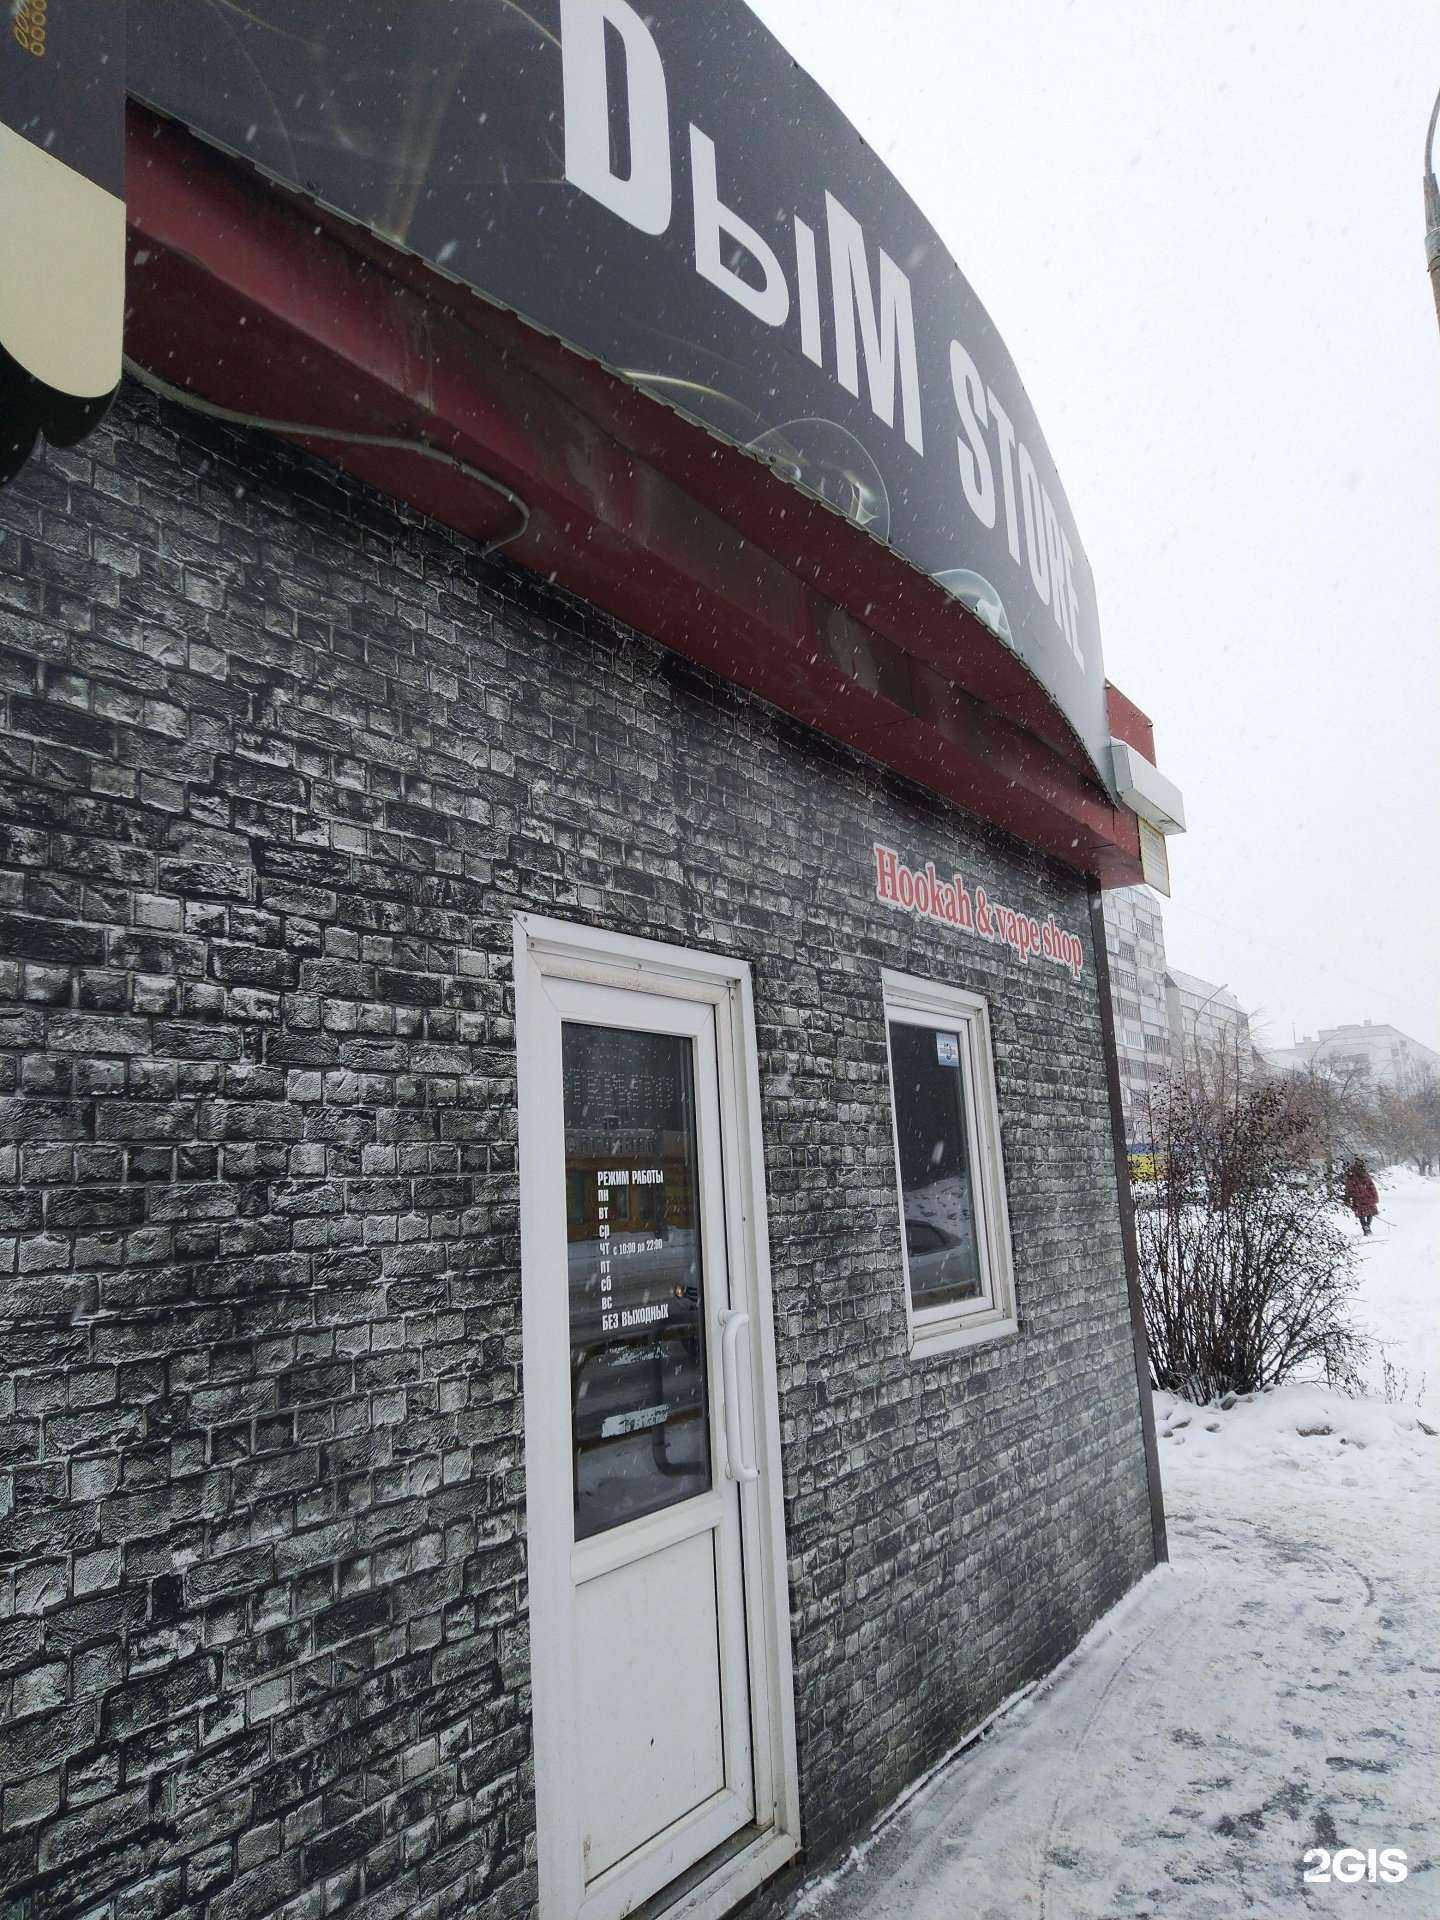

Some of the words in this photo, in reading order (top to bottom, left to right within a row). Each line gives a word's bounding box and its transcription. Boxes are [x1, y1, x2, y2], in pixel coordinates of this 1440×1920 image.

[949, 339, 1086, 675] STORE
[875, 845, 974, 931] Hookah
[975, 887, 995, 940] &
[994, 904, 1041, 961] vape
[1042, 915, 1084, 979] shop
[597, 1170, 629, 1186] РЕЖИМ
[632, 1169, 664, 1185] РАБОТЫ
[620, 1242, 636, 1254] 10:00
[637, 1242, 645, 1254] до
[646, 1239, 663, 1251] 22:00
[602, 1313, 619, 1331] БЕЗ
[621, 1303, 669, 1327] ВЫХОДНЫХ
